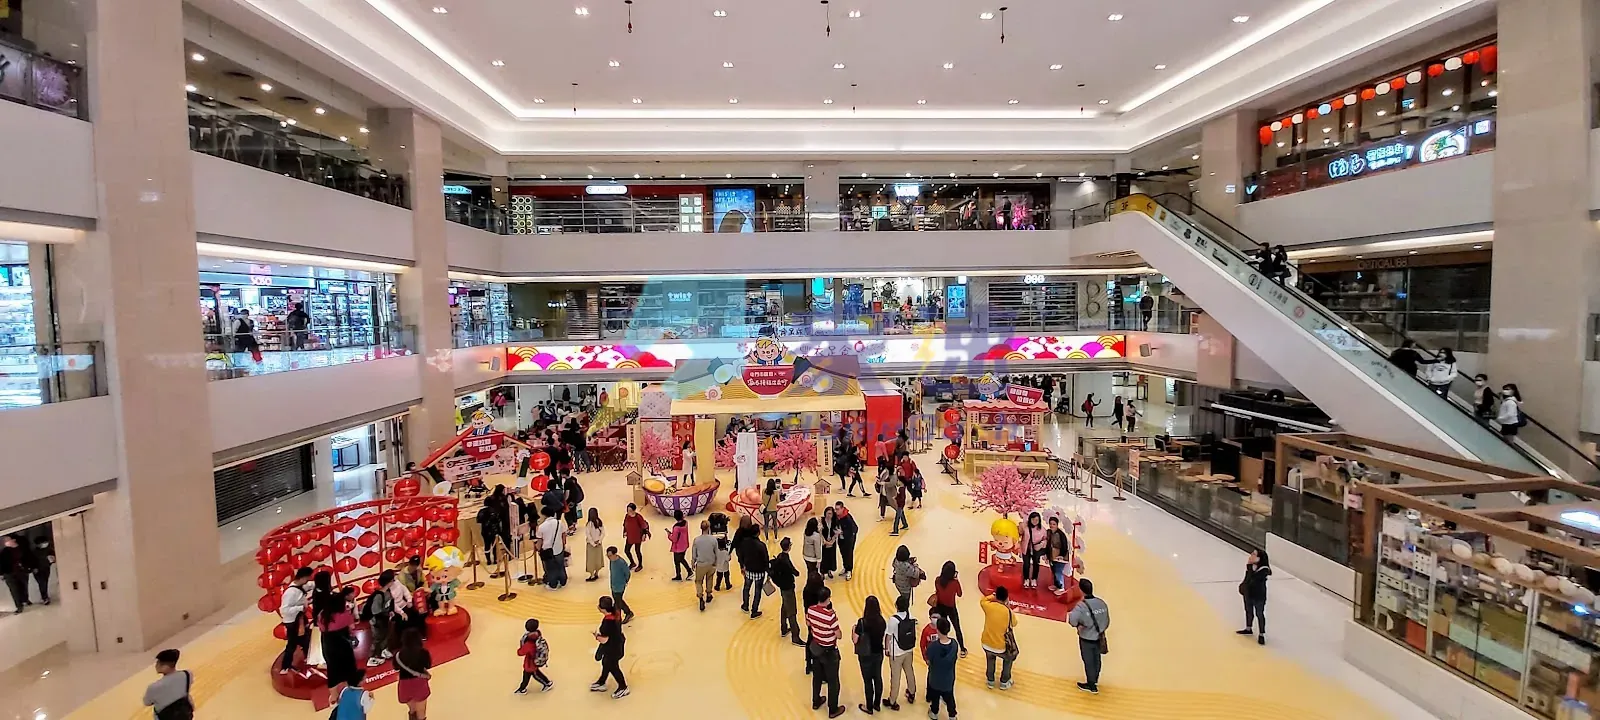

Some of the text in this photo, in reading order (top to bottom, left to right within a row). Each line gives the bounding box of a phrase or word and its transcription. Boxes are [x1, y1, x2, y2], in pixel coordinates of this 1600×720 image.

[1357, 258, 1408, 269] OPTICAL 88
[667, 291, 693, 299] twist
[365, 669, 396, 683] tmtplaz
